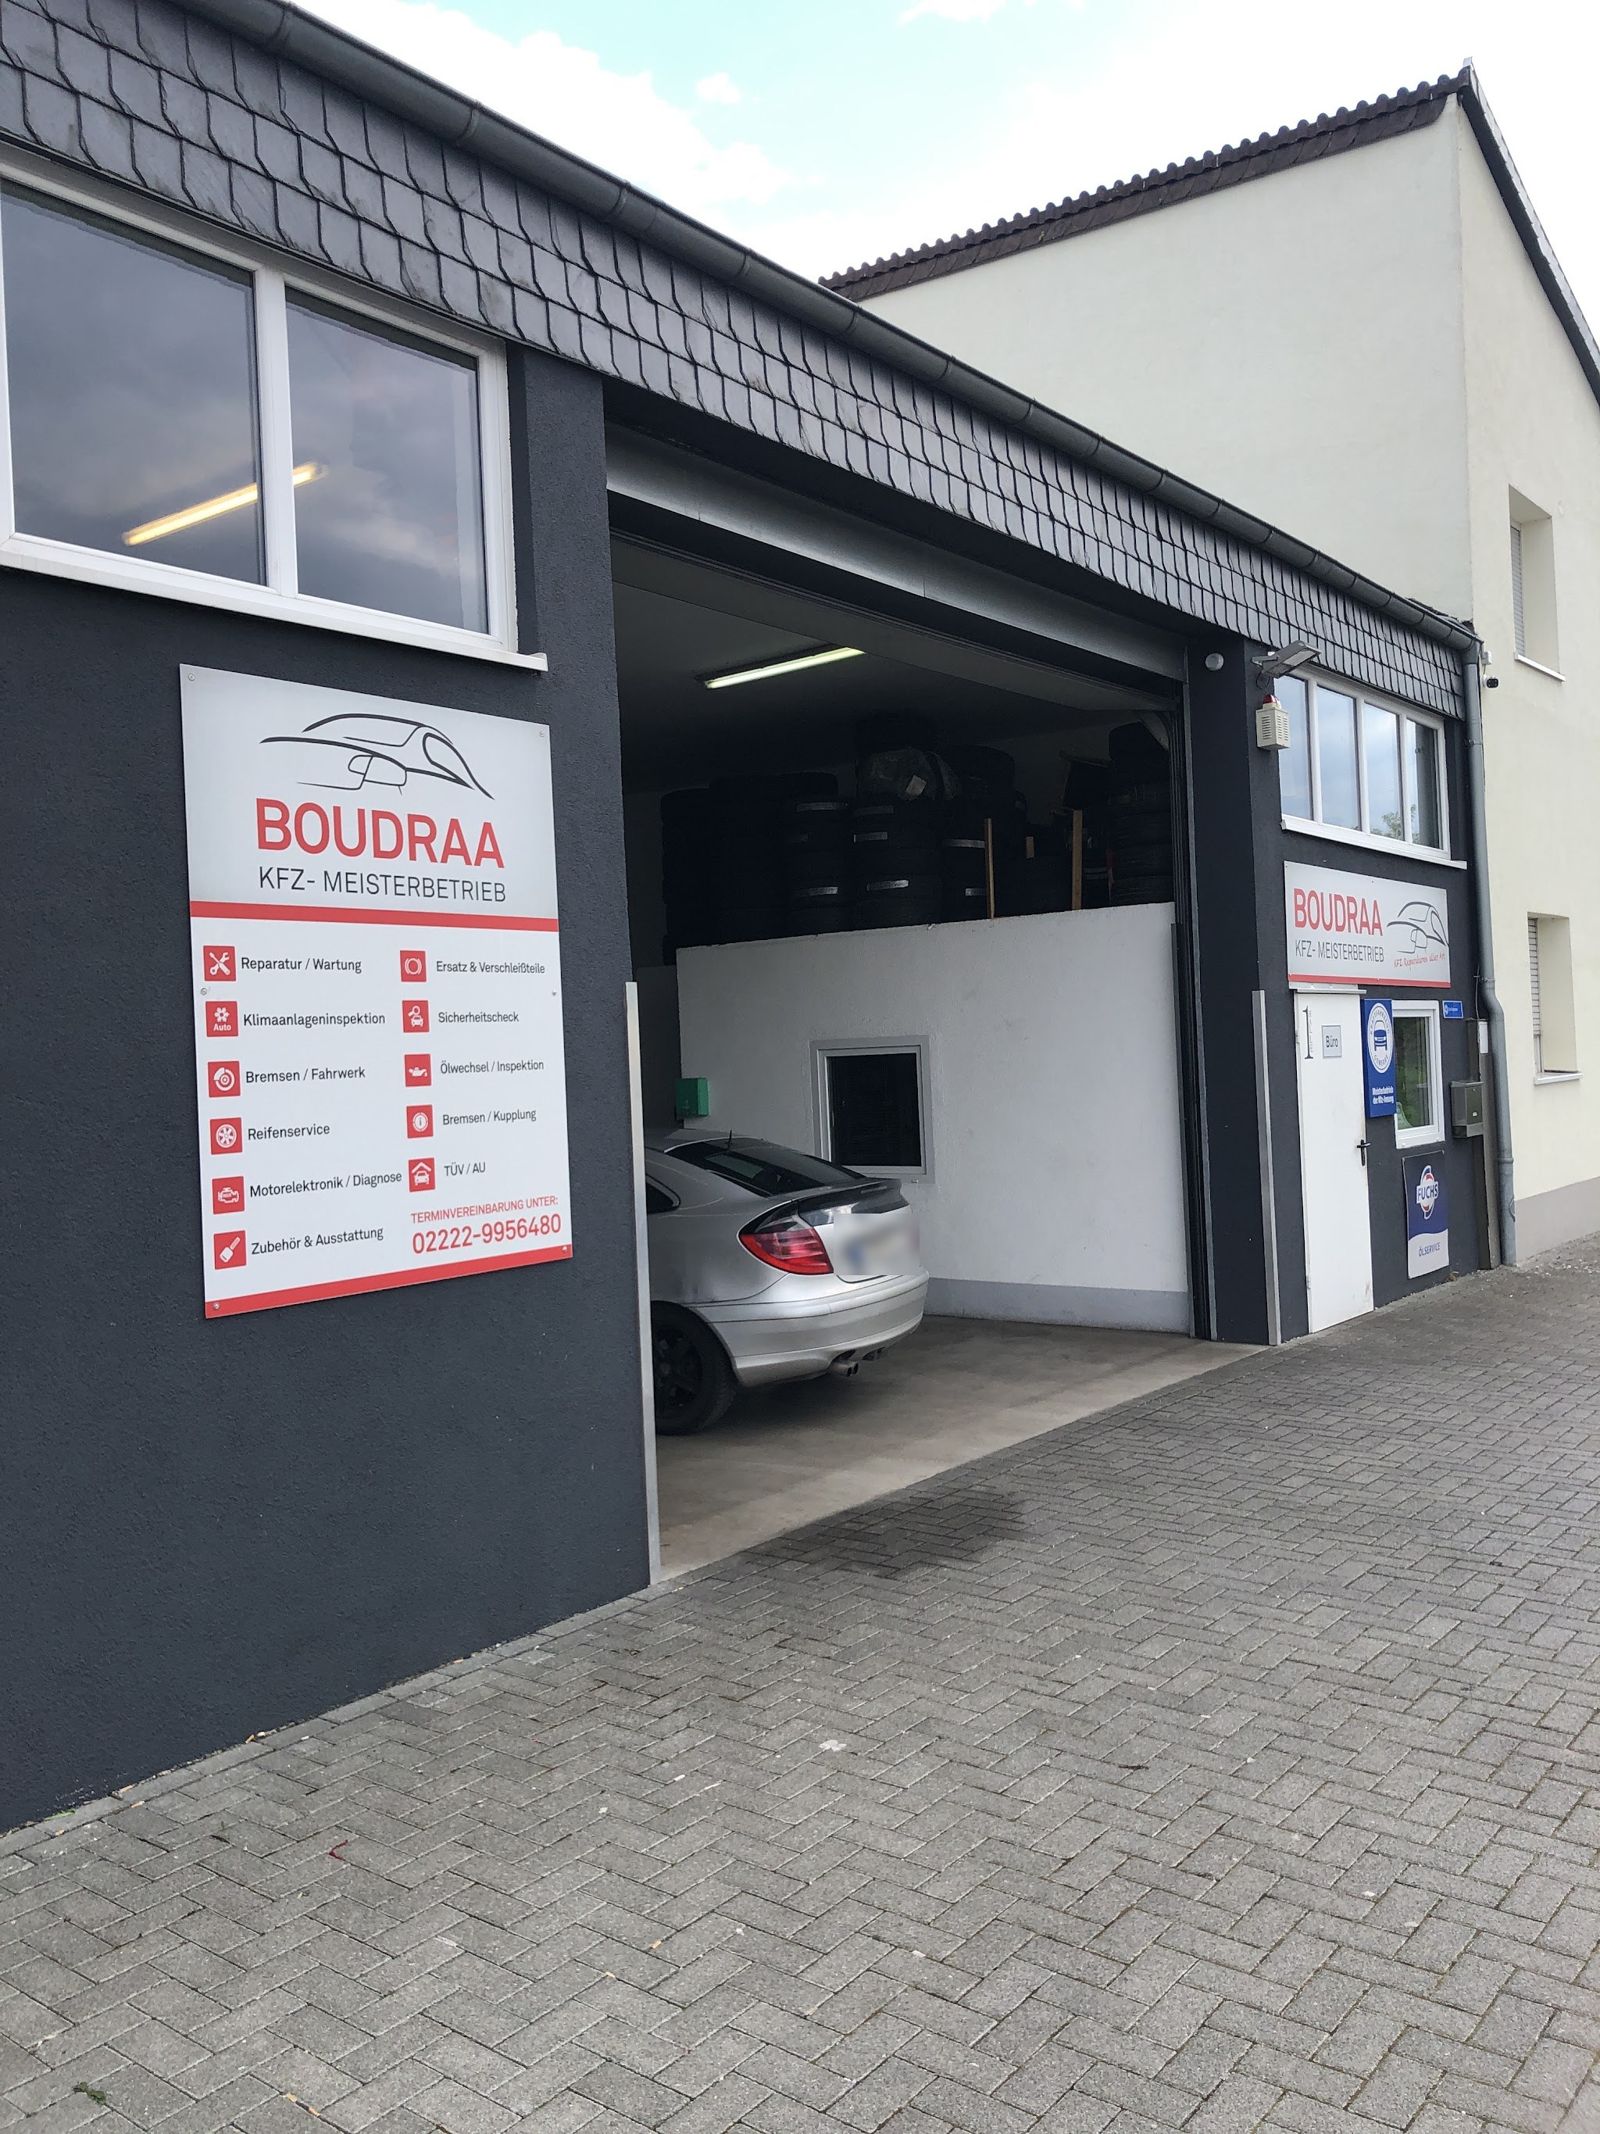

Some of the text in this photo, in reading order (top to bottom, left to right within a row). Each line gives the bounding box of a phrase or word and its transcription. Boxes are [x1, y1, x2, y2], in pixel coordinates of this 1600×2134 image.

[256, 798, 504, 869] BOUDRAA
[259, 866, 507, 903] KFZ- MEISTERBETRIEB
[1293, 888, 1383, 937] BOUDRAA
[1295, 939, 1385, 963] KFZ- MEISTERBETRIEB
[241, 957, 362, 974] Reparatur / Wartung
[436, 961, 546, 974] Ersatz & Verschleißteile
[243, 1012, 386, 1028] Klimaanlageninspektion
[438, 1011, 520, 1023] Sicherheitscheck
[213, 1023, 232, 1032] Auto
[246, 1066, 366, 1084] Bremsen / Fahrwerk
[440, 1059, 545, 1074] Ölwechsel / Inspektion
[443, 1112, 485, 1126] Bremsen
[494, 1109, 537, 1122] Kupplung
[248, 1123, 331, 1141] Reifenservice
[444, 1162, 465, 1177] TÜV
[472, 1161, 486, 1174] AU
[250, 1176, 344, 1198] Motorelektronik
[353, 1172, 403, 1188] Diagnose
[1417, 1183, 1439, 1201] FUCHS
[411, 1195, 559, 1224] TERMINVEREINBARUNG UNTER:
[251, 1227, 384, 1255] Zubehör & Ausstattung
[412, 1213, 562, 1254] 02222-9956480
